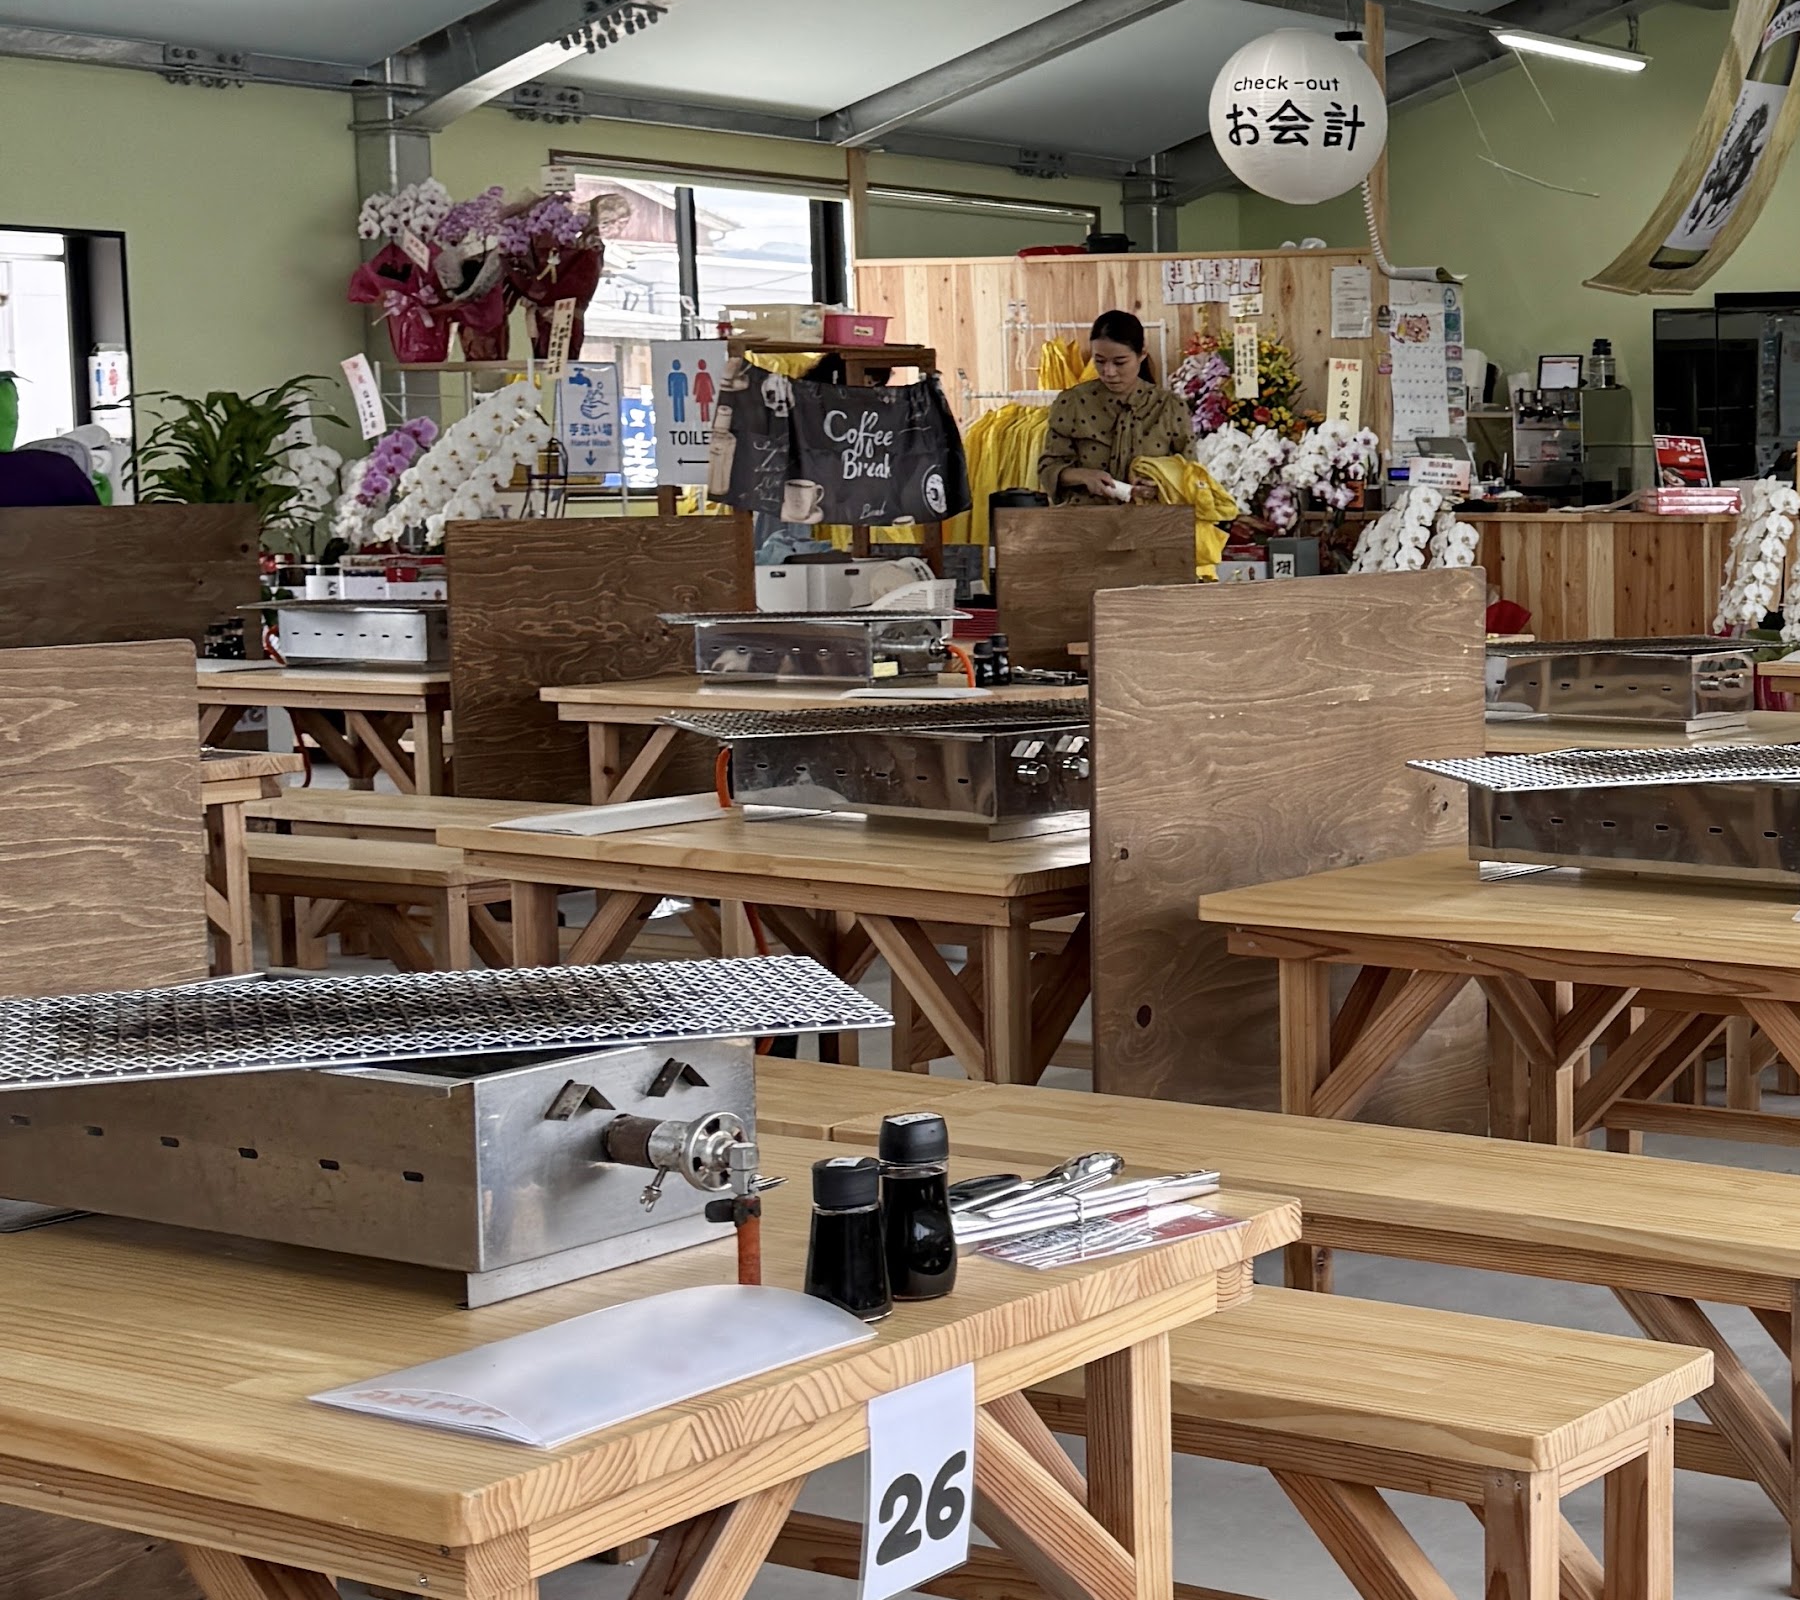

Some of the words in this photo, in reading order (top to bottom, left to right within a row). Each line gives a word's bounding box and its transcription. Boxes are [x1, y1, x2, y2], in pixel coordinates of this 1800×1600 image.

[1226, 99, 1366, 151] お会計
[569, 423, 612, 436] 手洗い場
[669, 430, 714, 446] TOILE
[823, 409, 894, 459] Coffee
[842, 448, 892, 480] Break
[874, 1449, 968, 1567] 26
